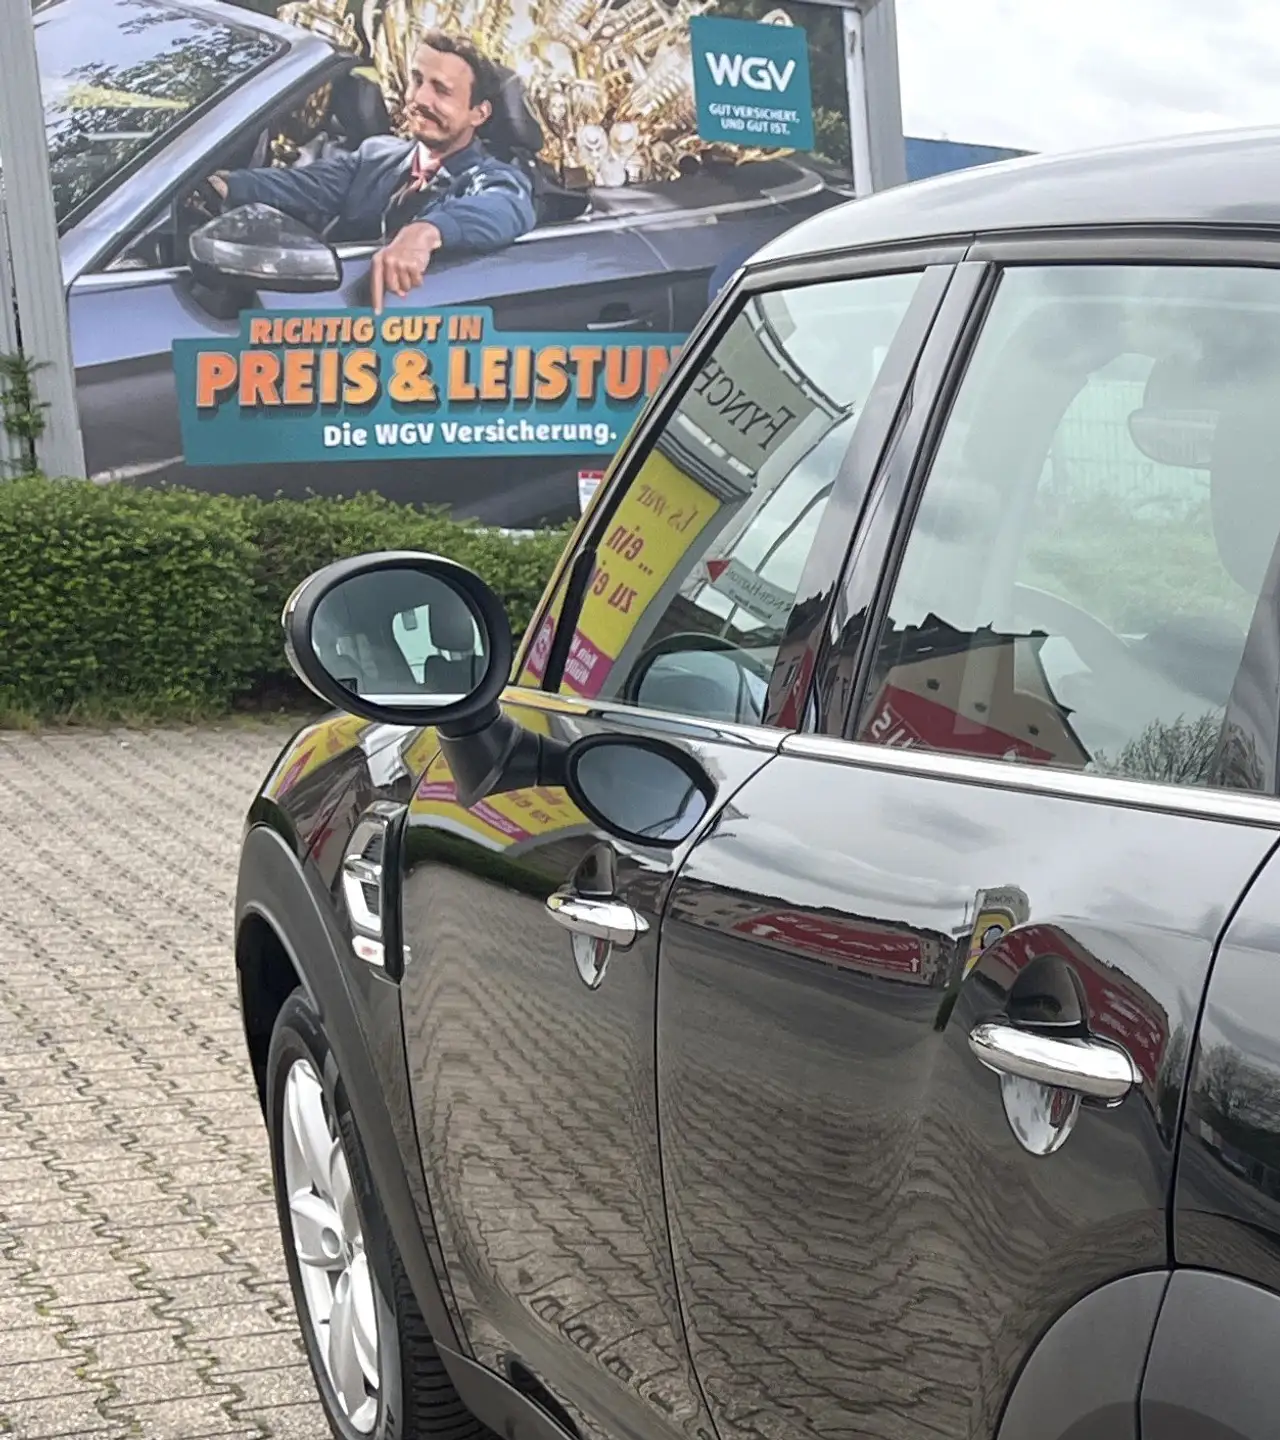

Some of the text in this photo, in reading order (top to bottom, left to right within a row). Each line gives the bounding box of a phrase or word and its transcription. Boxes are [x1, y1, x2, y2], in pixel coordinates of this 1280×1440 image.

[705, 52, 796, 92] WGV
[709, 103, 731, 116] GUT
[721, 118, 744, 131] UND
[746, 120, 769, 132] GUT
[249, 315, 483, 344] RICHTIG GUT IN
[197, 348, 381, 408] PREIS
[387, 350, 437, 402] &
[323, 421, 617, 448] Die WGV Versicherung.
